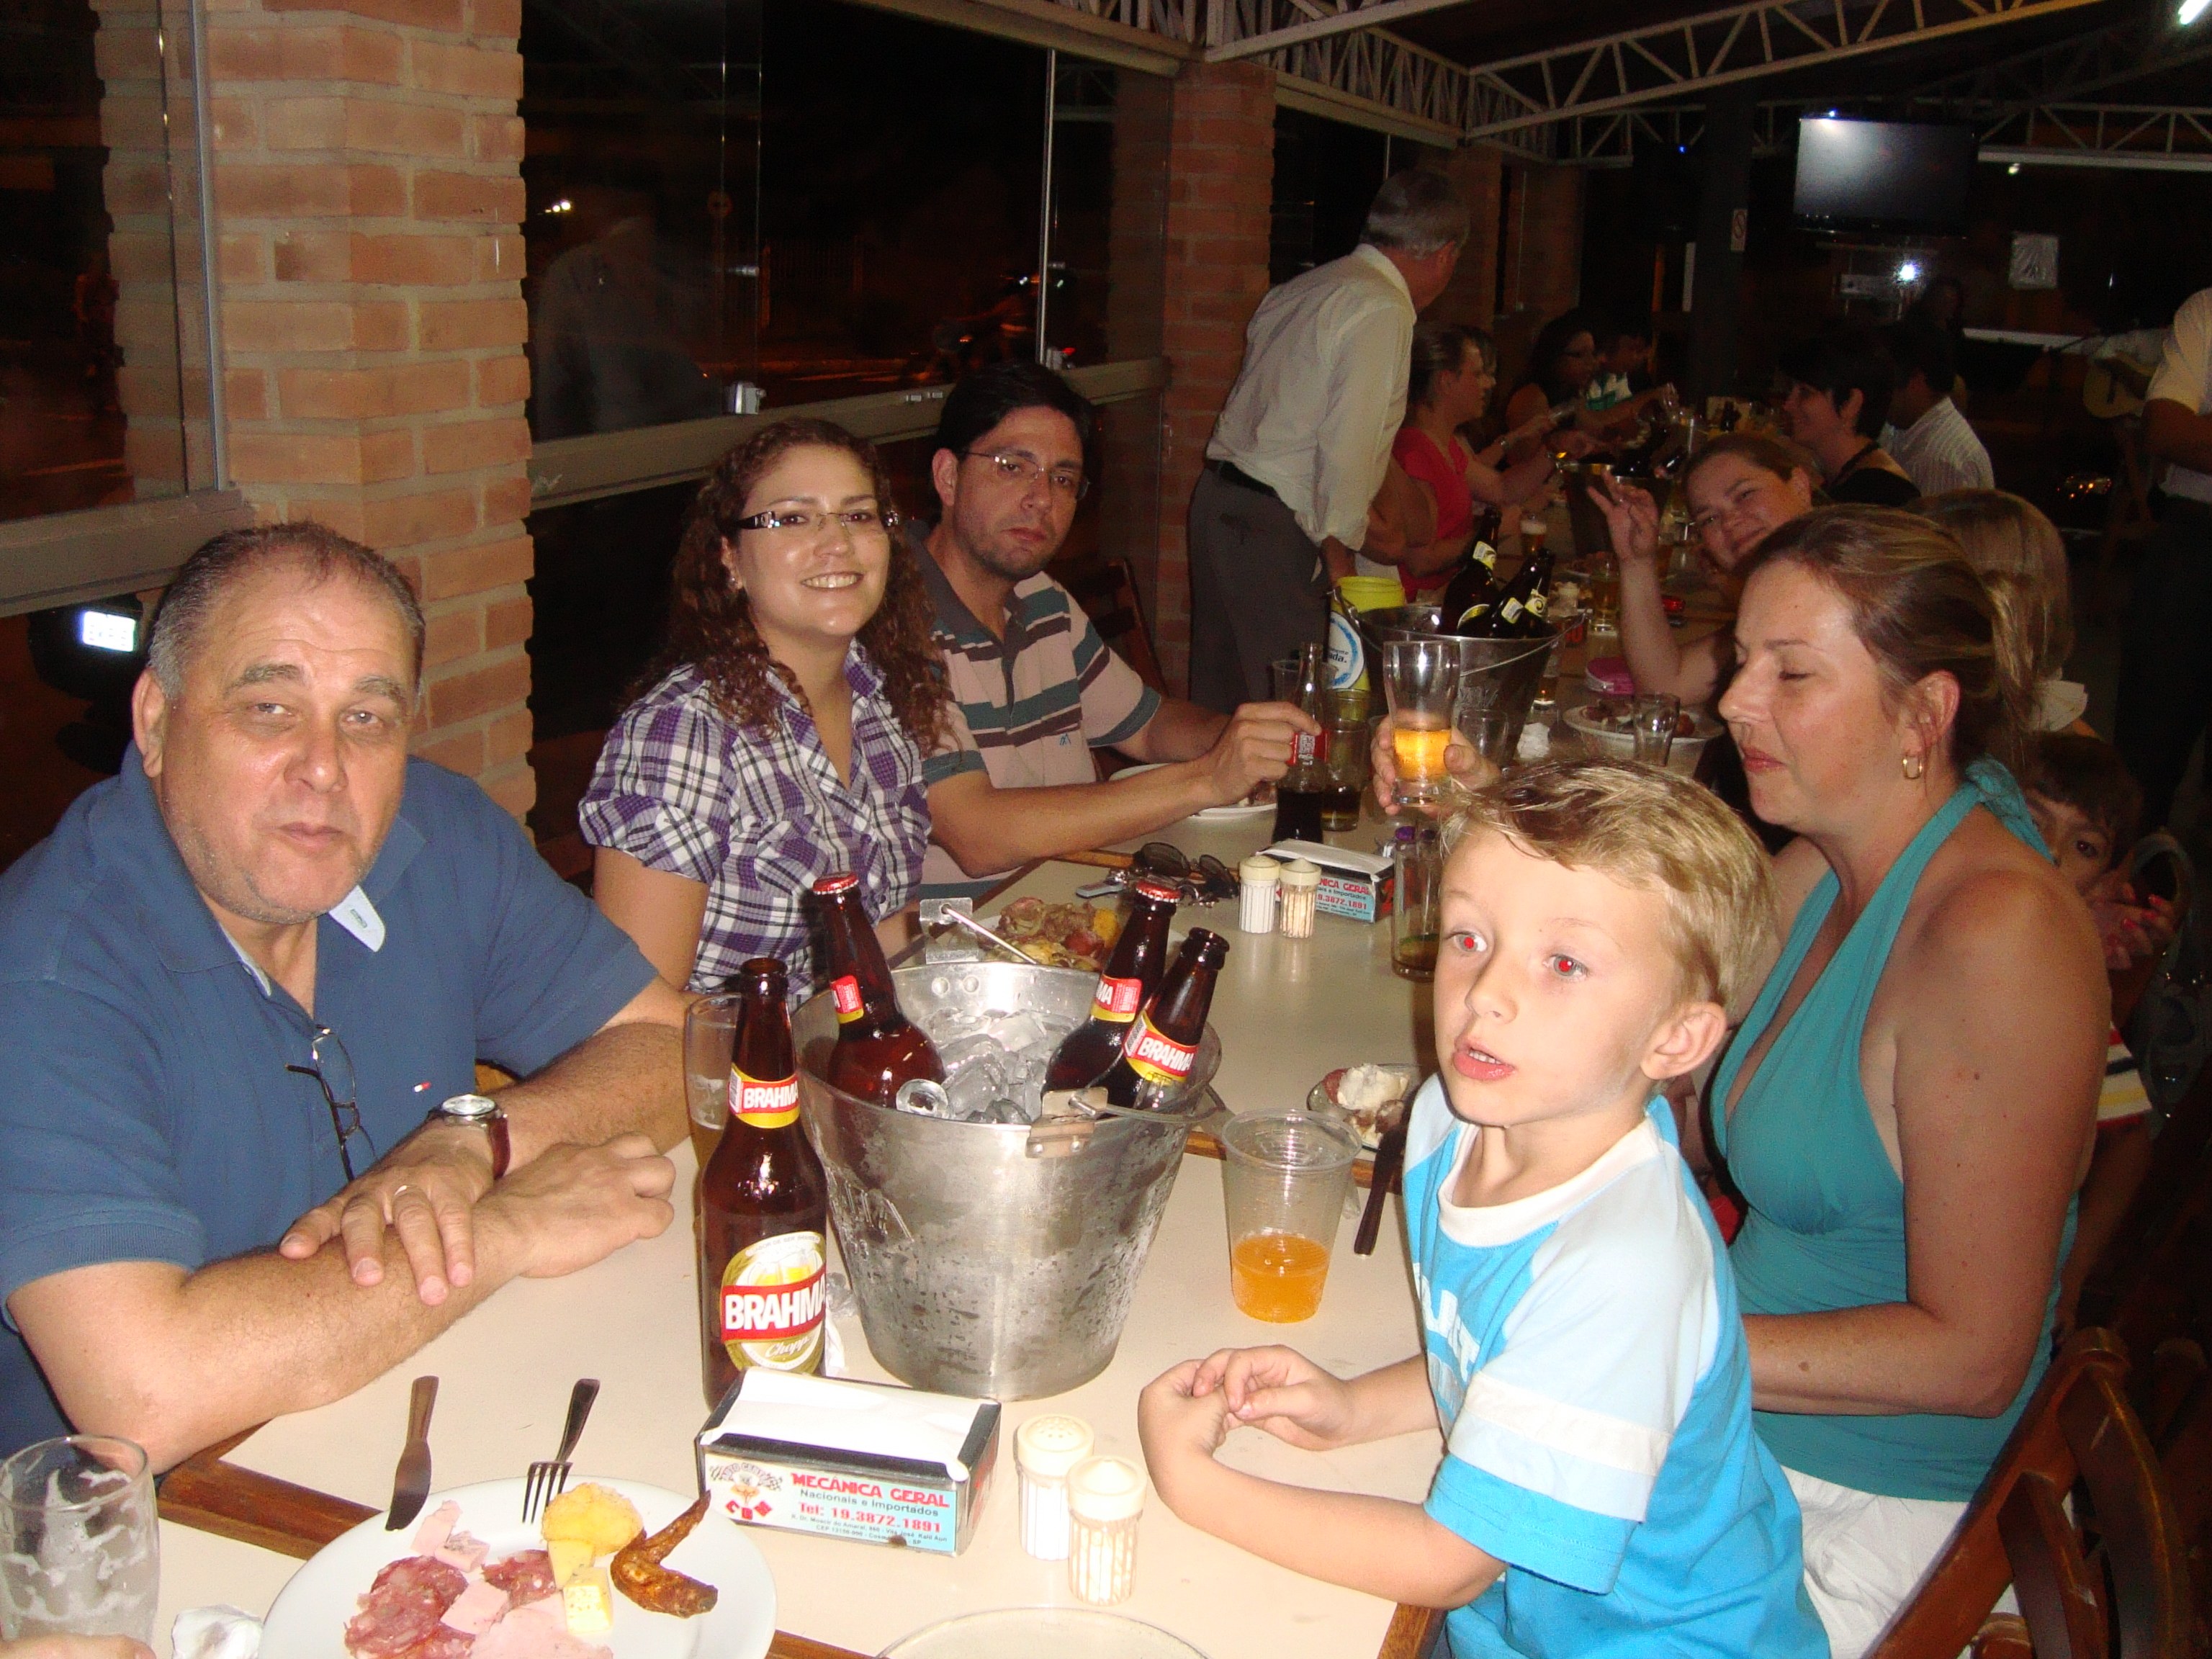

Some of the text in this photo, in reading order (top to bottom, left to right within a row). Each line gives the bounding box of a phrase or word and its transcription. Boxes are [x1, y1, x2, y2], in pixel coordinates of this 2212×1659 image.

[1138, 1037, 1195, 1071] BRAHMA
[743, 1080, 799, 1109] BRAHMA
[725, 1273, 826, 1330] BRAHMA
[791, 1473, 950, 1508] MECÂNICA GERAL
[801, 1488, 857, 1504] Nacionais
[872, 1499, 938, 1516] Importados
[799, 1502, 940, 1533] Tel: 19.3872.1891
